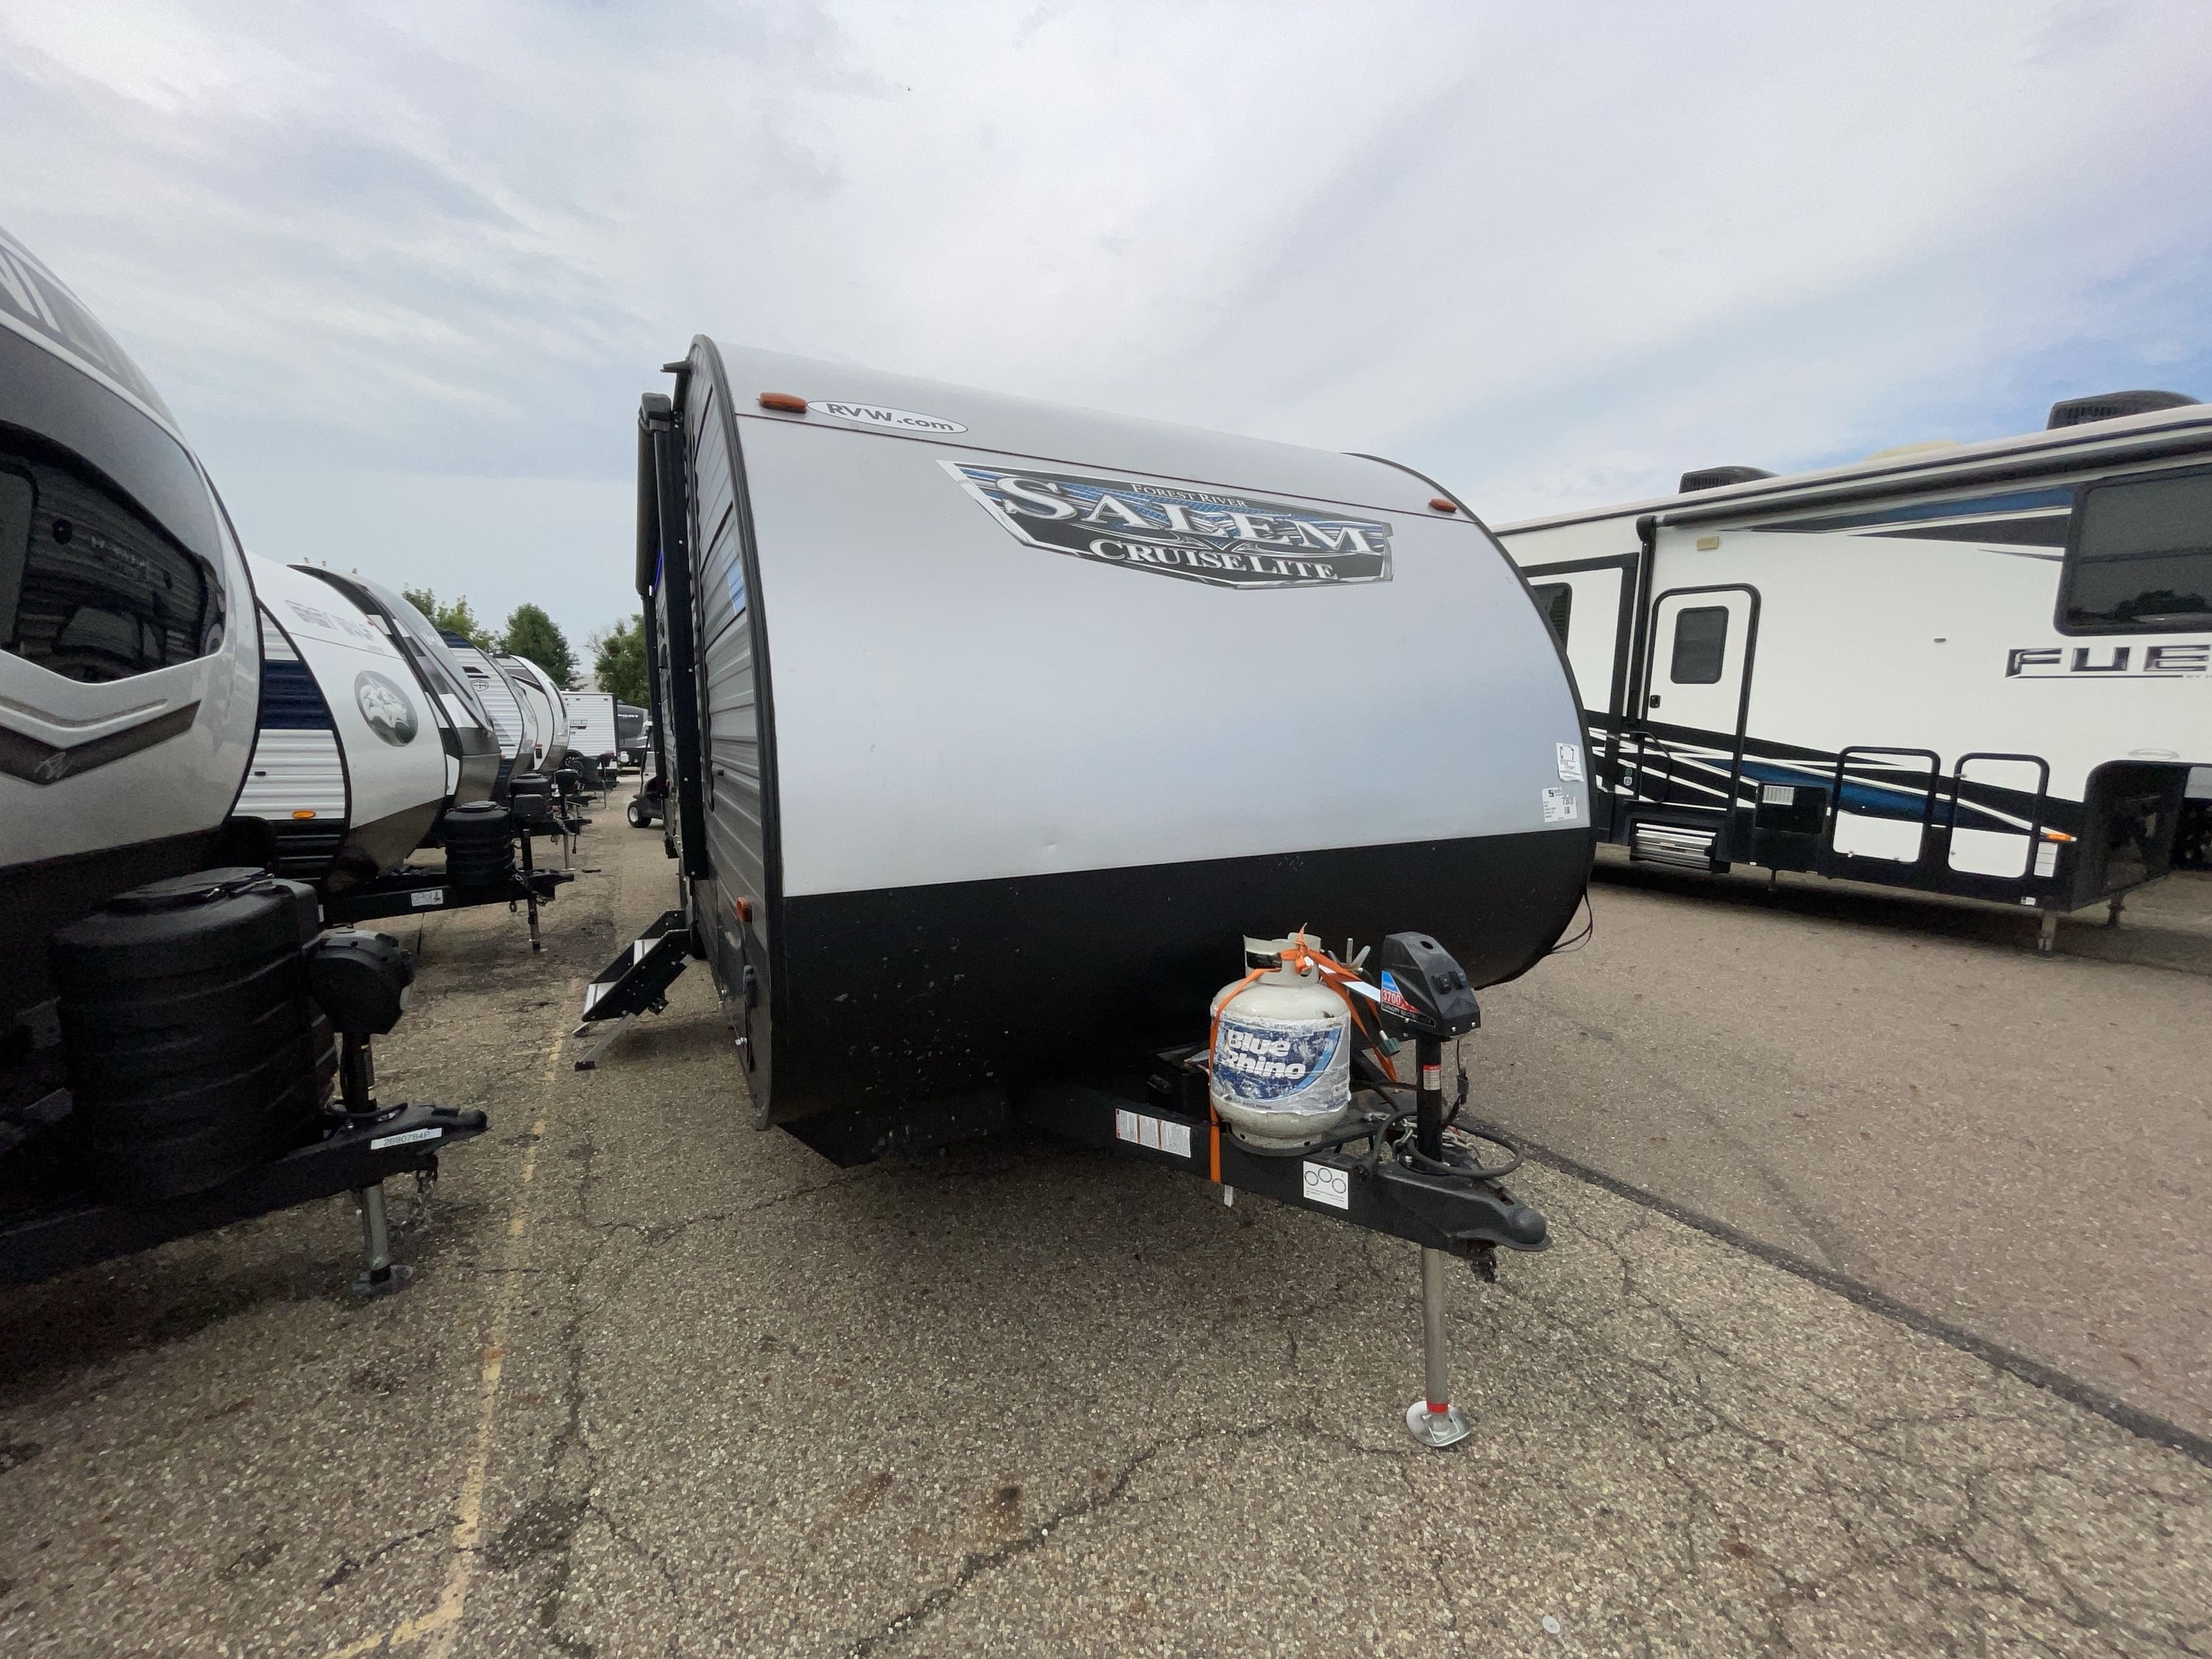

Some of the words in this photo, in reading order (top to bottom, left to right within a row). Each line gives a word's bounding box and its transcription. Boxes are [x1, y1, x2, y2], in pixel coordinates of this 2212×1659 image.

[826, 403, 954, 431] RVW.com
[1130, 484, 1195, 500] FOREST
[1197, 493, 1248, 507] RIVER
[995, 476, 1385, 556] SALEM
[1382, 990, 1401, 1005] 3700
[1228, 1029, 1291, 1057] Blue
[1224, 1049, 1307, 1079] Rhino
